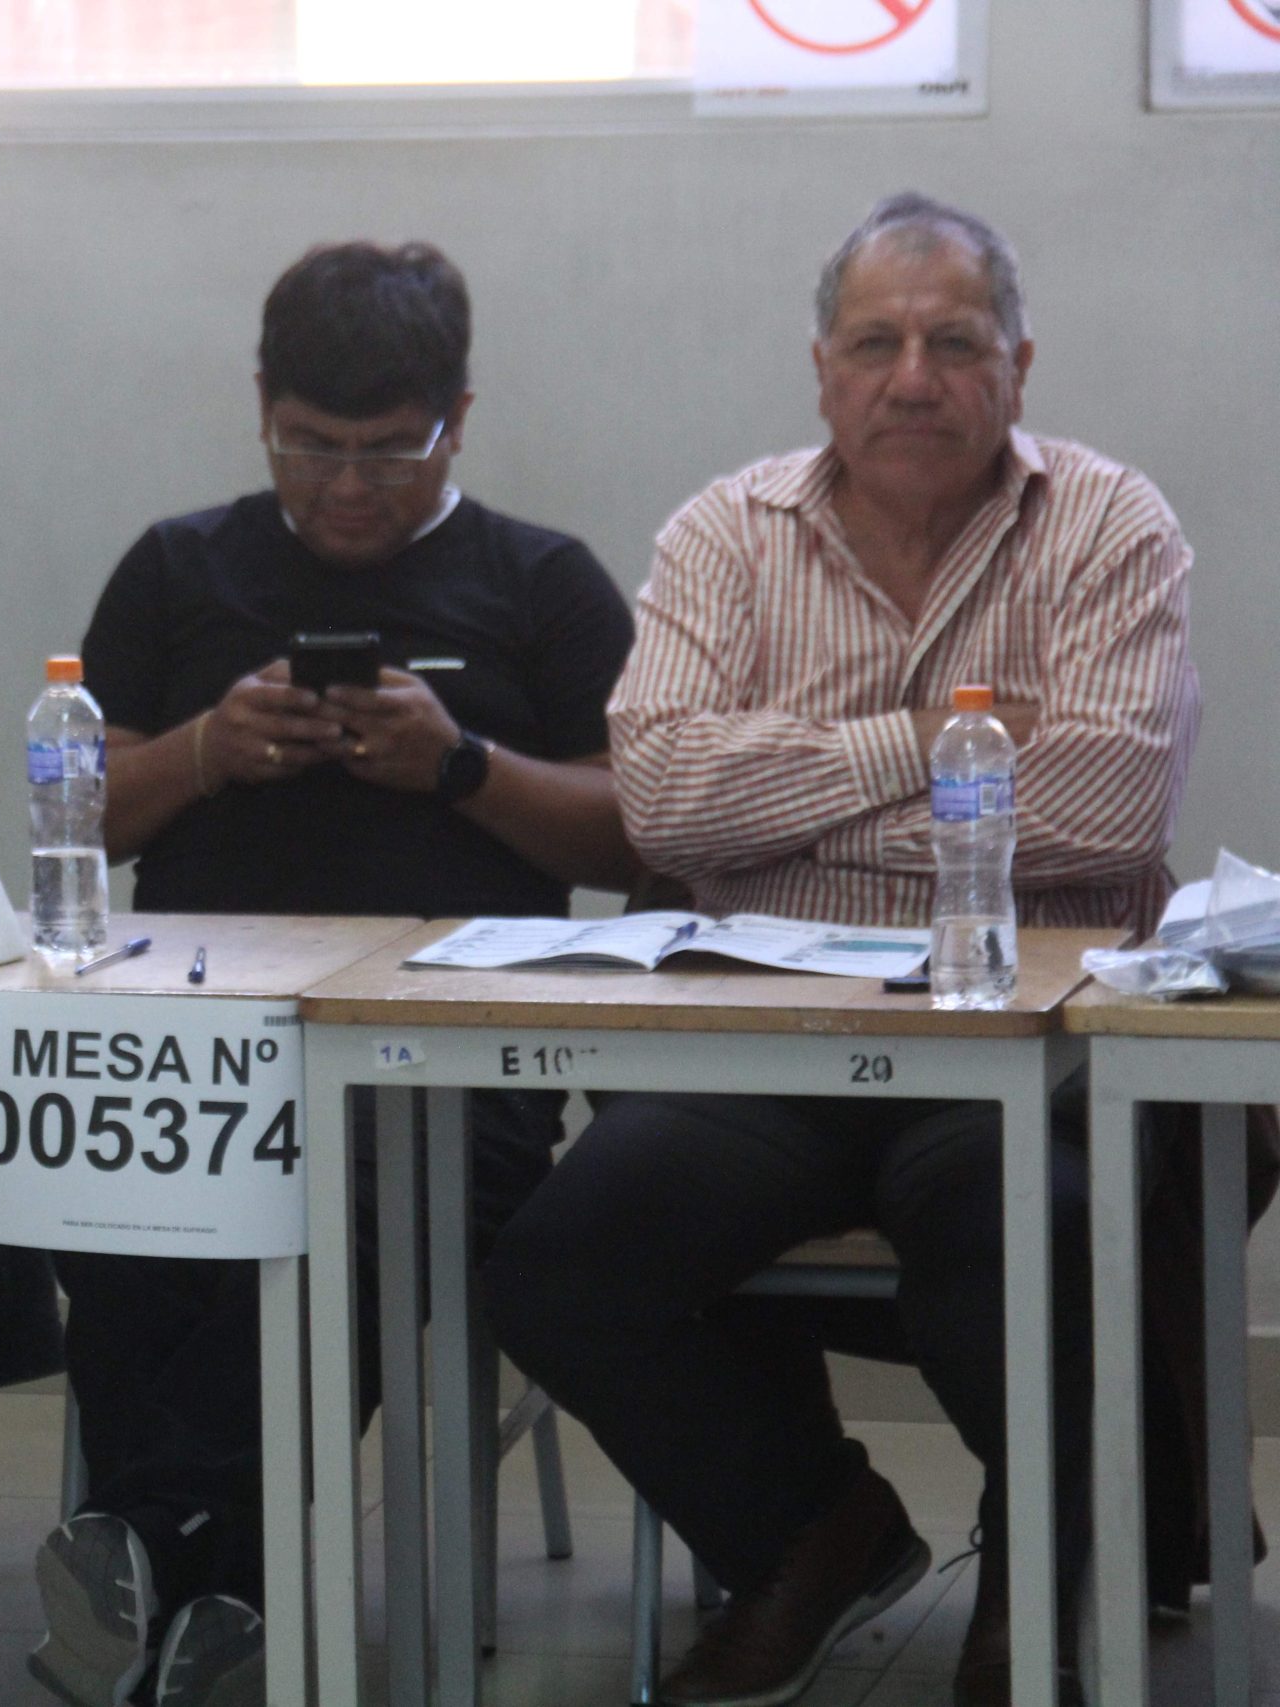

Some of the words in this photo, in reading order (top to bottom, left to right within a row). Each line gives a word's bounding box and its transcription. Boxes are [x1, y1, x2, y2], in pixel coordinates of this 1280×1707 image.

[12, 1028, 191, 1084] MESA
[501, 1045, 521, 1076] E
[533, 1046, 597, 1076] 10
[850, 1053, 893, 1083] 20
